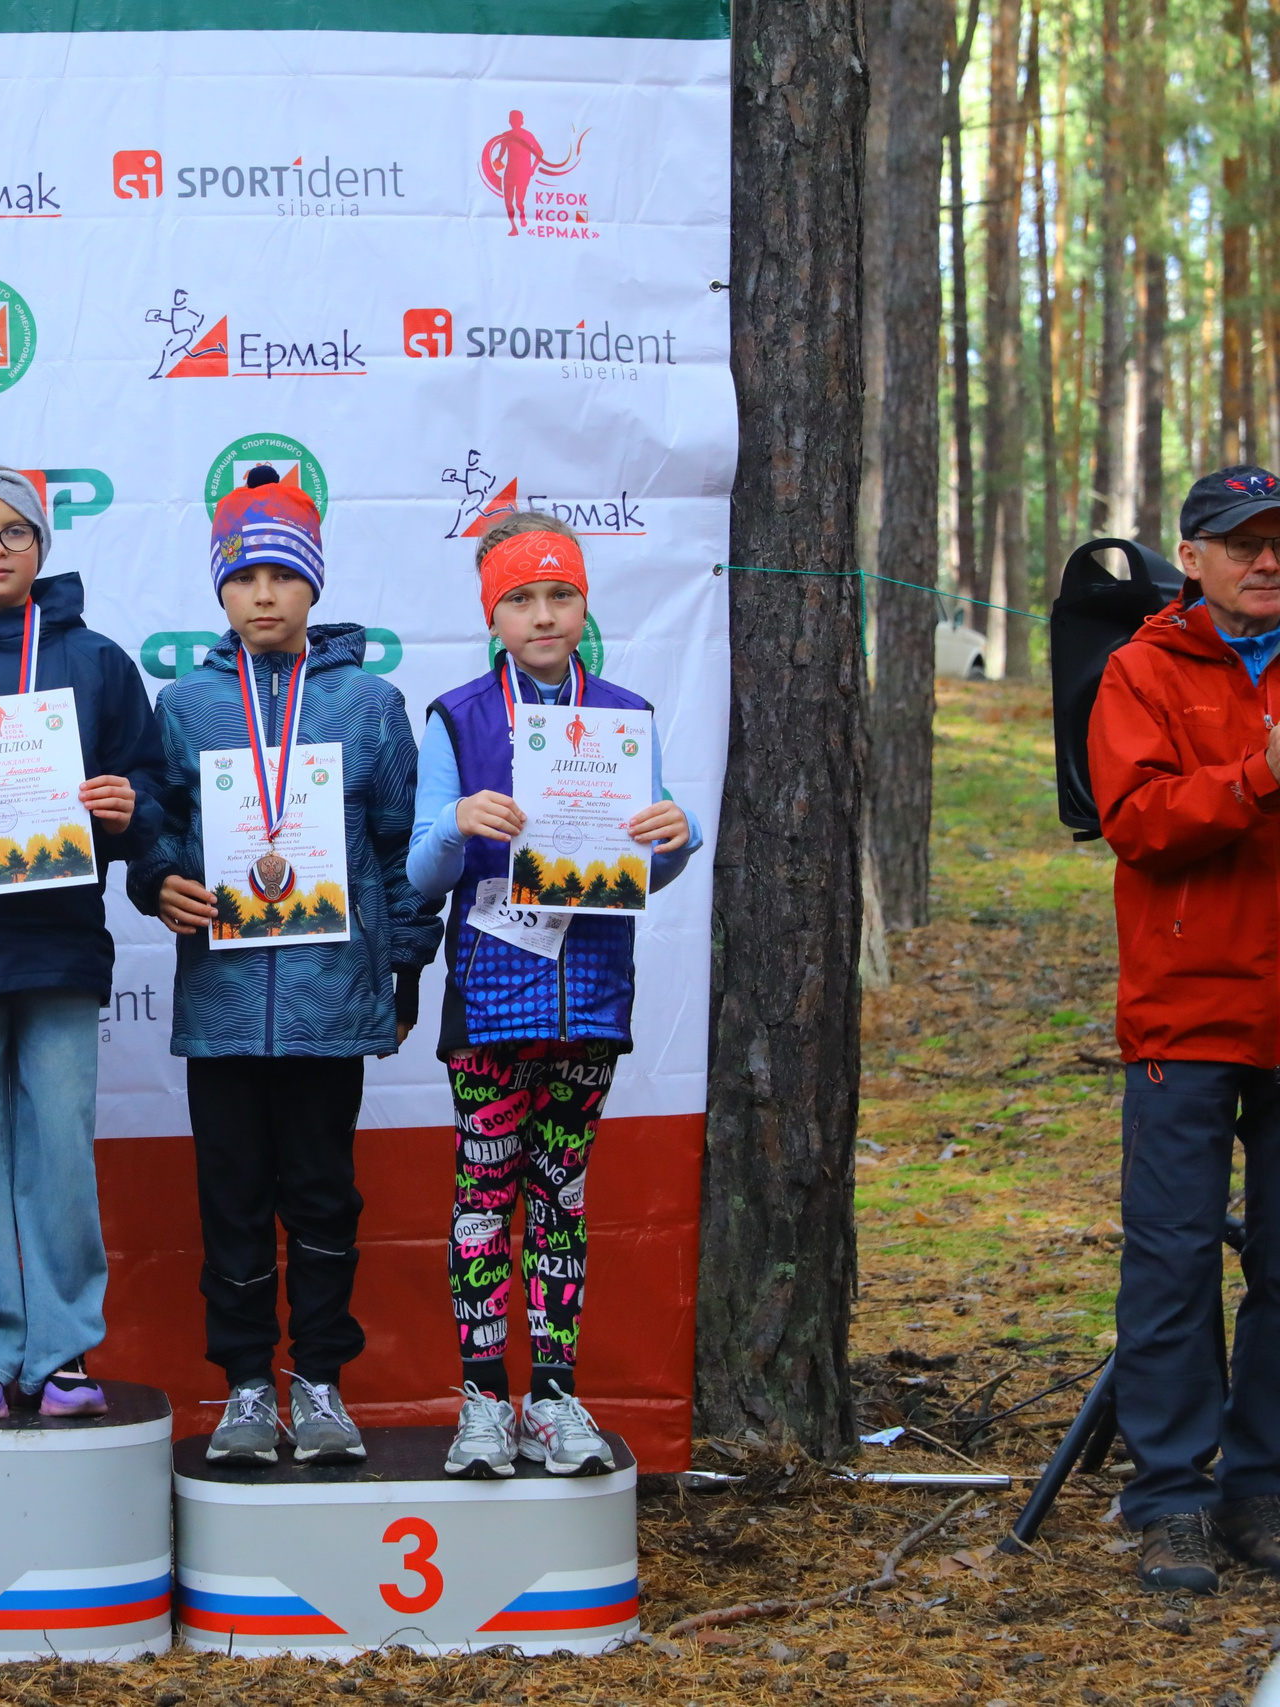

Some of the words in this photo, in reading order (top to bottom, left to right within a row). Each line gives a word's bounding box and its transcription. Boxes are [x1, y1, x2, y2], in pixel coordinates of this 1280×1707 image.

[176, 155, 405, 198] SPORTident
[277, 199, 360, 217] siberia
[535, 192, 588, 206] КУБОК
[535, 209, 569, 222] КСО
[527, 225, 600, 240] «ЕРМАК»
[7, 304, 31, 379] ОРИЕНТИРОВАНИЯ
[240, 328, 366, 379] Ермак
[466, 320, 677, 364] SPORTident
[561, 362, 639, 381] siberia
[211, 449, 238, 497] ФЕДЕРАЦИЯ
[241, 438, 303, 458] СПОРТИВНОГО
[527, 490, 645, 532] Ермак
[551, 759, 617, 774] ДИПЛОМ
[557, 779, 613, 787] НАГРАЖДАЕТСЯ
[455, 1072, 501, 1102] love
[463, 1258, 511, 1287] love
[380, 1517, 443, 1615] 3
